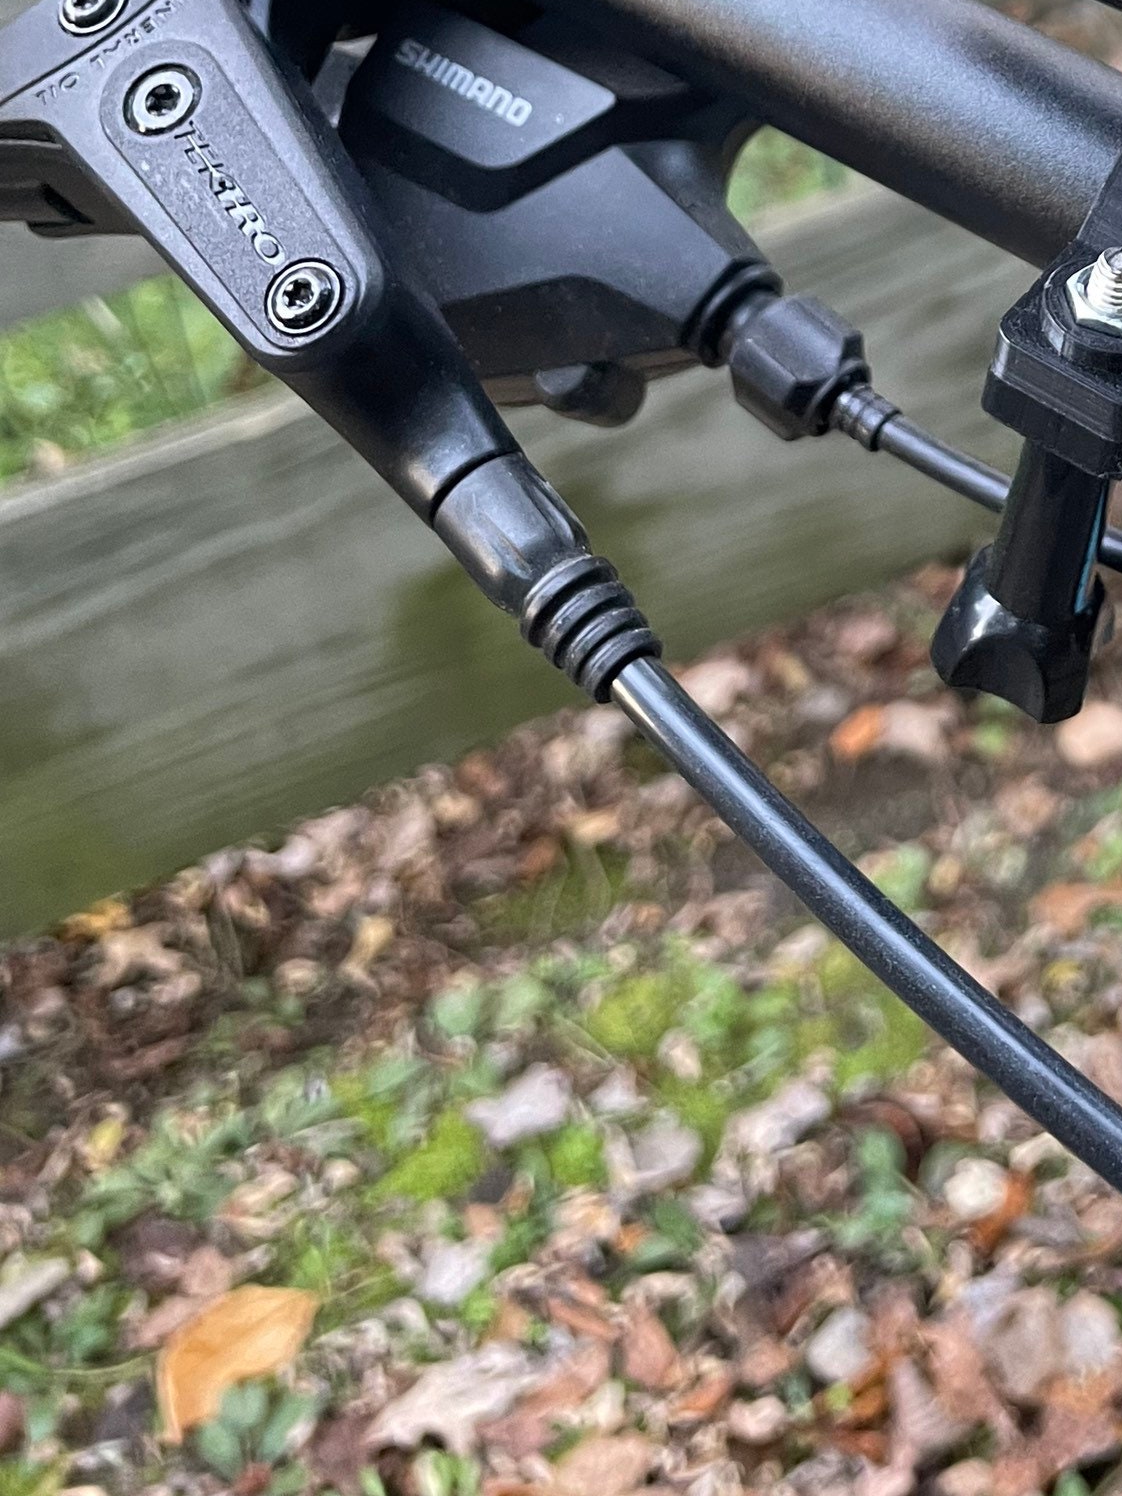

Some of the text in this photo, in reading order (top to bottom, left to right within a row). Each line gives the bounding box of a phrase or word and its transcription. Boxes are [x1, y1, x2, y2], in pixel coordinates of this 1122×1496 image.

[35, 71, 81, 106] OIL
[395, 38, 533, 127] SHIMANO
[174, 120, 286, 266] TEKTRO
